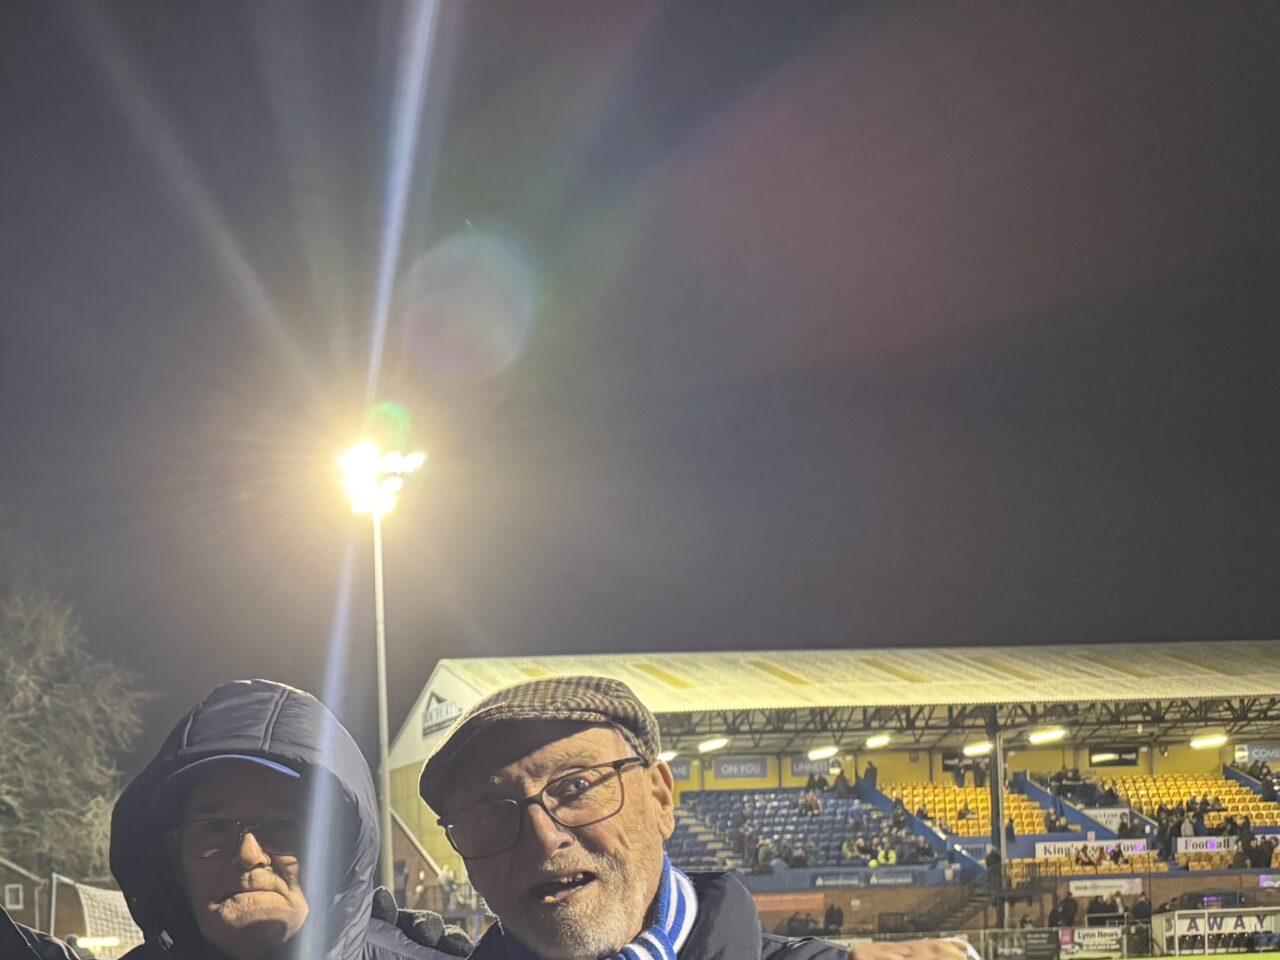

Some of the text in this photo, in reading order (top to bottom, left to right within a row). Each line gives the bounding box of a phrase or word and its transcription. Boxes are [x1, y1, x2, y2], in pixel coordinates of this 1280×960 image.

[672, 764, 687, 776] ME
[721, 763, 760, 775] ON YOU
[1186, 914, 1268, 932] AWAY
